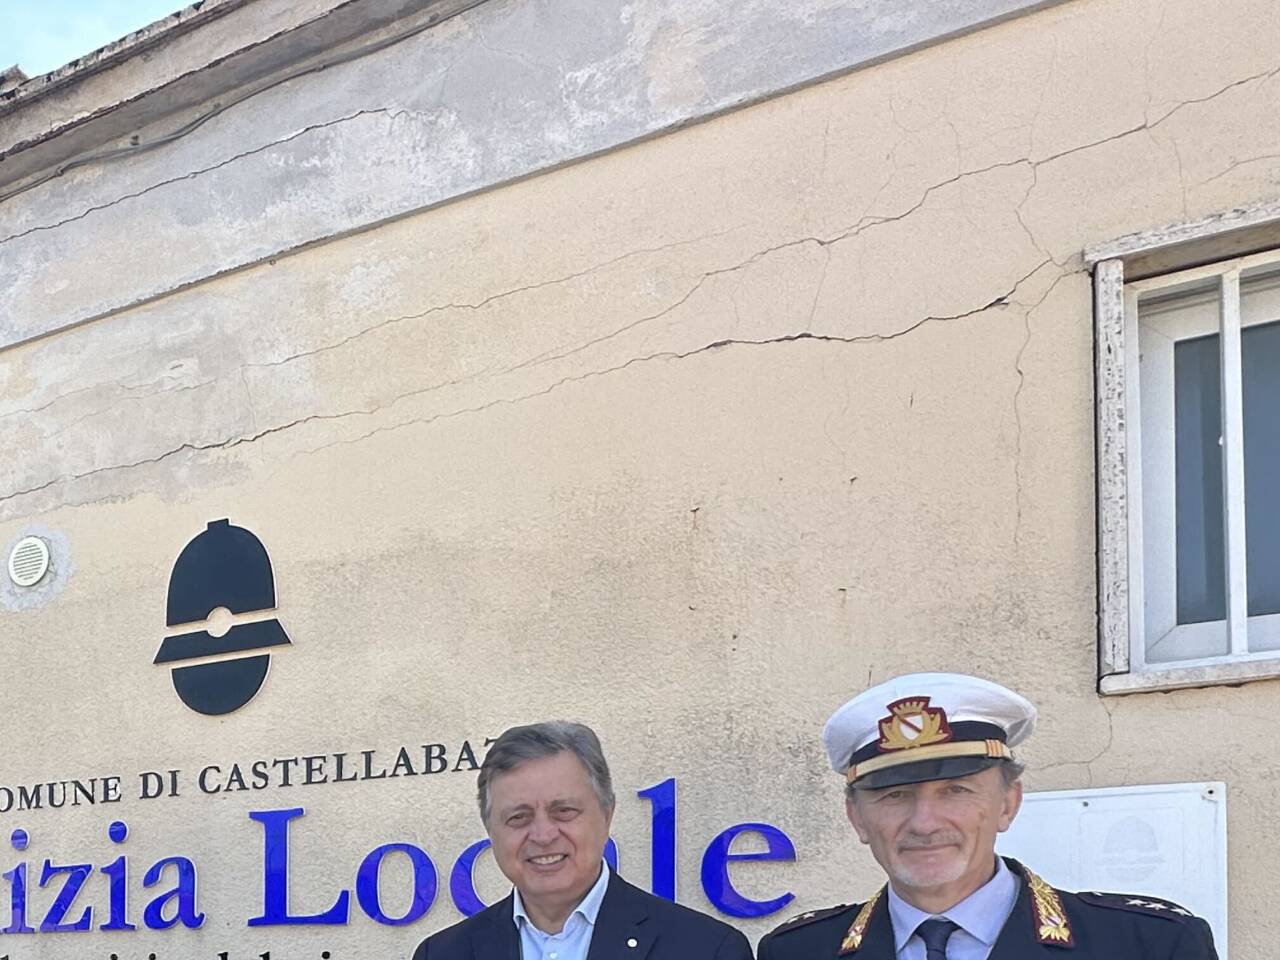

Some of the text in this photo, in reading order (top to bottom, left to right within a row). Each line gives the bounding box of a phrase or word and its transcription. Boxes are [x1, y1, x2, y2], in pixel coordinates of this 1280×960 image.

[139, 770, 180, 800] DI
[197, 738, 497, 794] CASTELLABA
[247, 777, 797, 928] Locle
